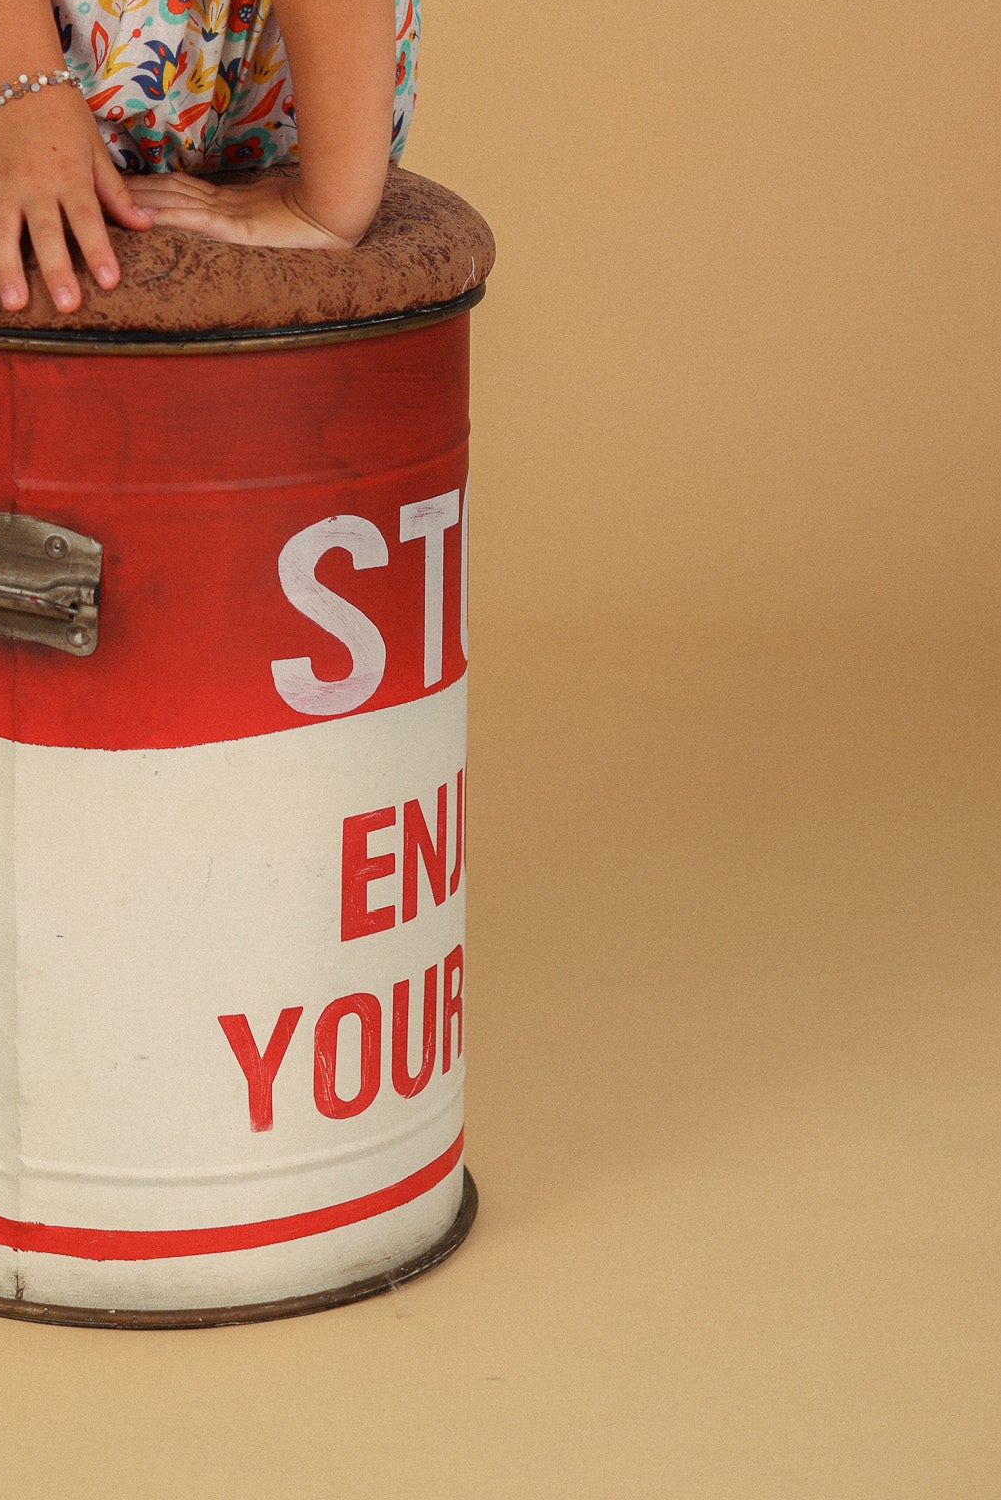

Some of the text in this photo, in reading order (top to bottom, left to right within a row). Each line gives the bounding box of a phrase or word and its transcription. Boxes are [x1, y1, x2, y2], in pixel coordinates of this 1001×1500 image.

[271, 474, 469, 717] ST
[341, 757, 467, 942] ENJ
[217, 944, 464, 1132] YOUR
